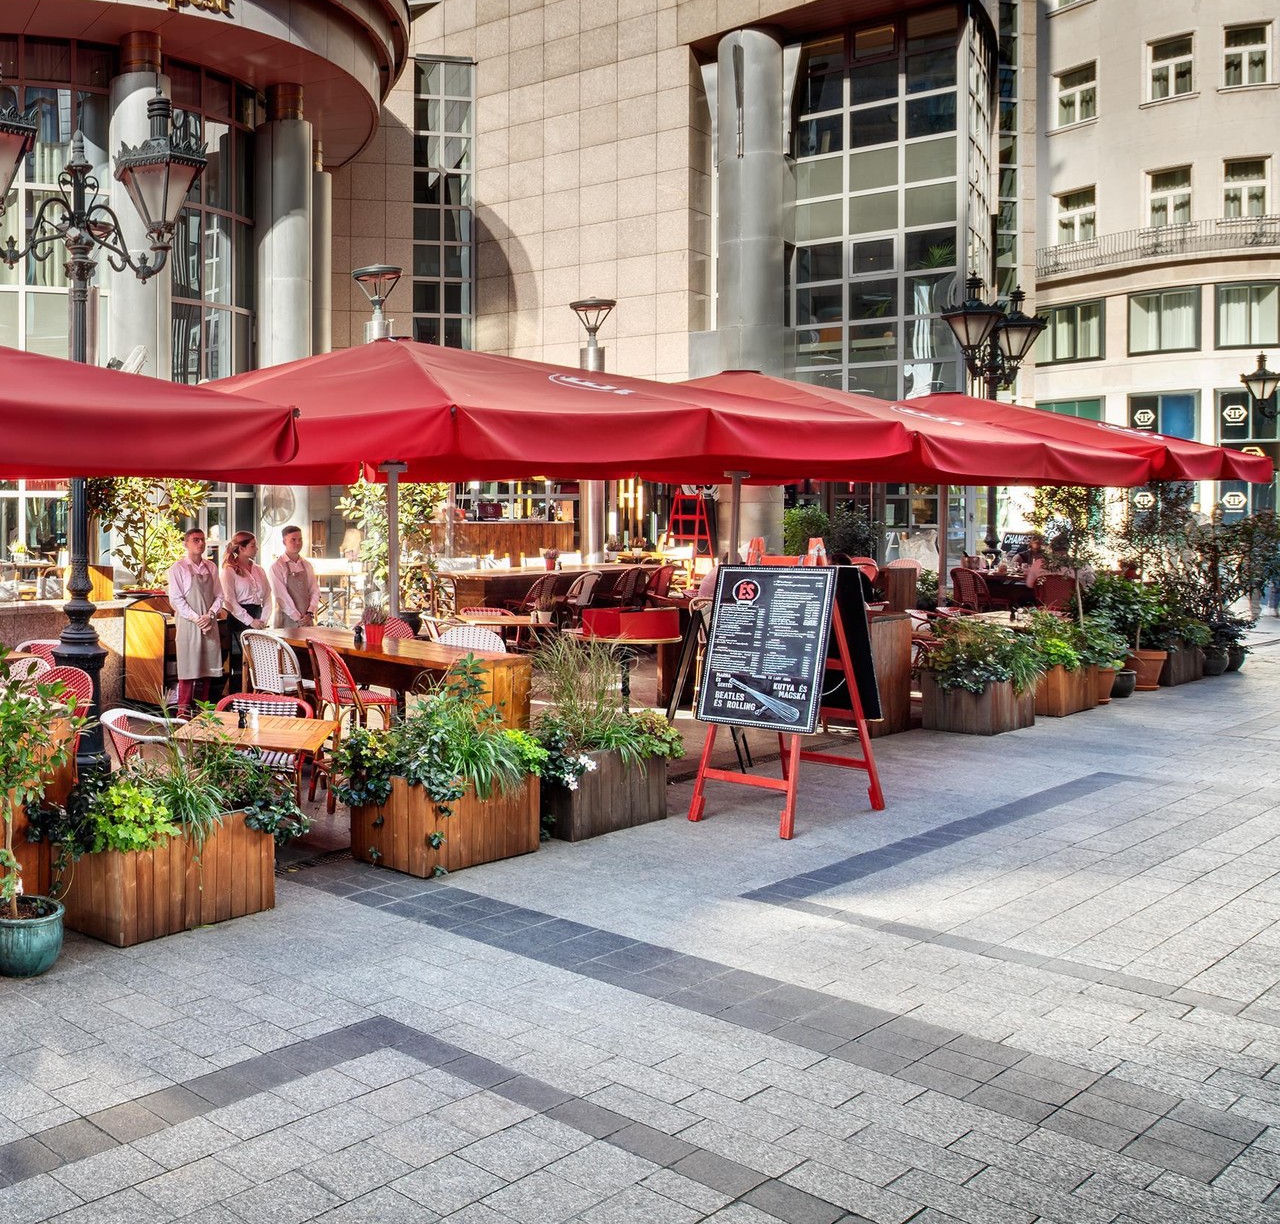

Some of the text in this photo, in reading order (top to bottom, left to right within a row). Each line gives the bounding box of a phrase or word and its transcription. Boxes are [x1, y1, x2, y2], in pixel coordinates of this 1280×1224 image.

[738, 582, 755, 599] ÉS
[773, 682, 795, 692] KUTYA
[715, 691, 745, 701] BEATLES
[778, 691, 806, 700] MACSKA
[714, 698, 756, 711] ÉS ROLLING
